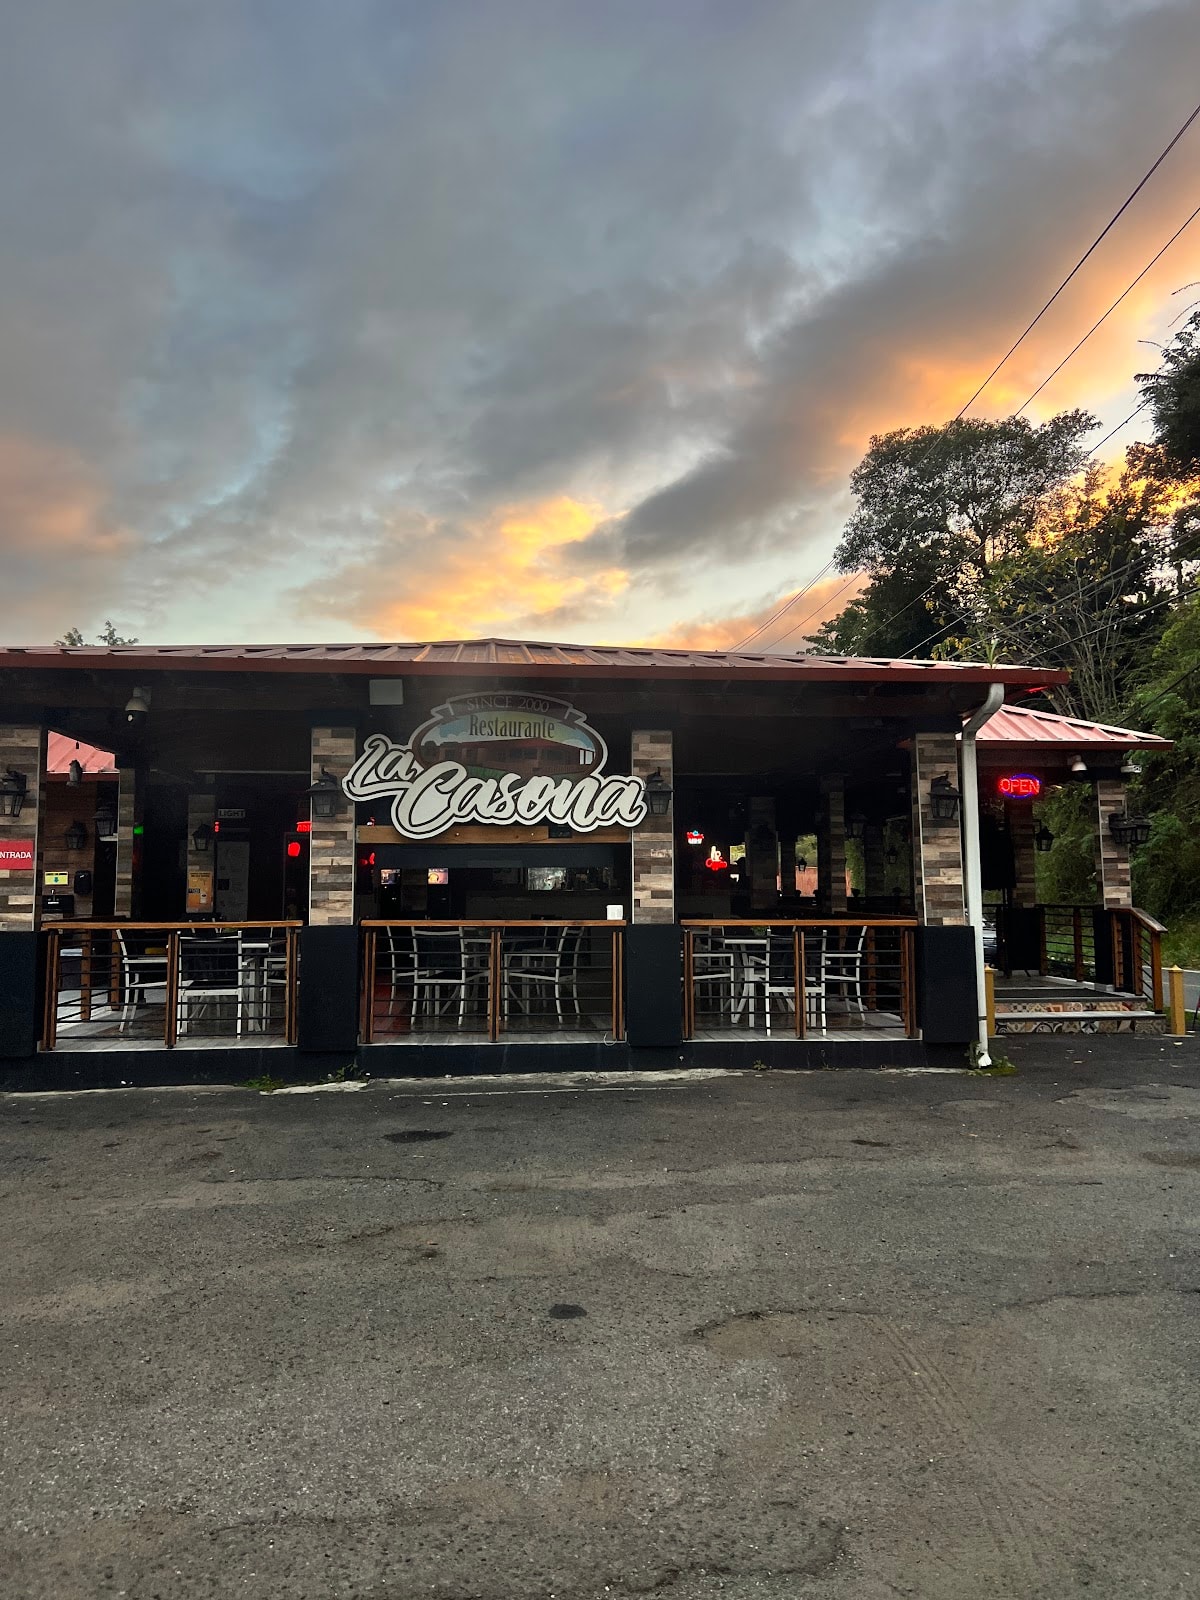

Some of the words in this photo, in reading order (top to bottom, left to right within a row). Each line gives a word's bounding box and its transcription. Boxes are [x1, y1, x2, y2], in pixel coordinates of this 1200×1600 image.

[466, 696, 514, 711] SINCE
[517, 696, 550, 713] 2000
[468, 713, 556, 739] Restaurante
[346, 735, 424, 797] La
[999, 777, 1041, 795] OPEN
[395, 761, 645, 836] Casona
[0, 851, 32, 859] NTRADA
